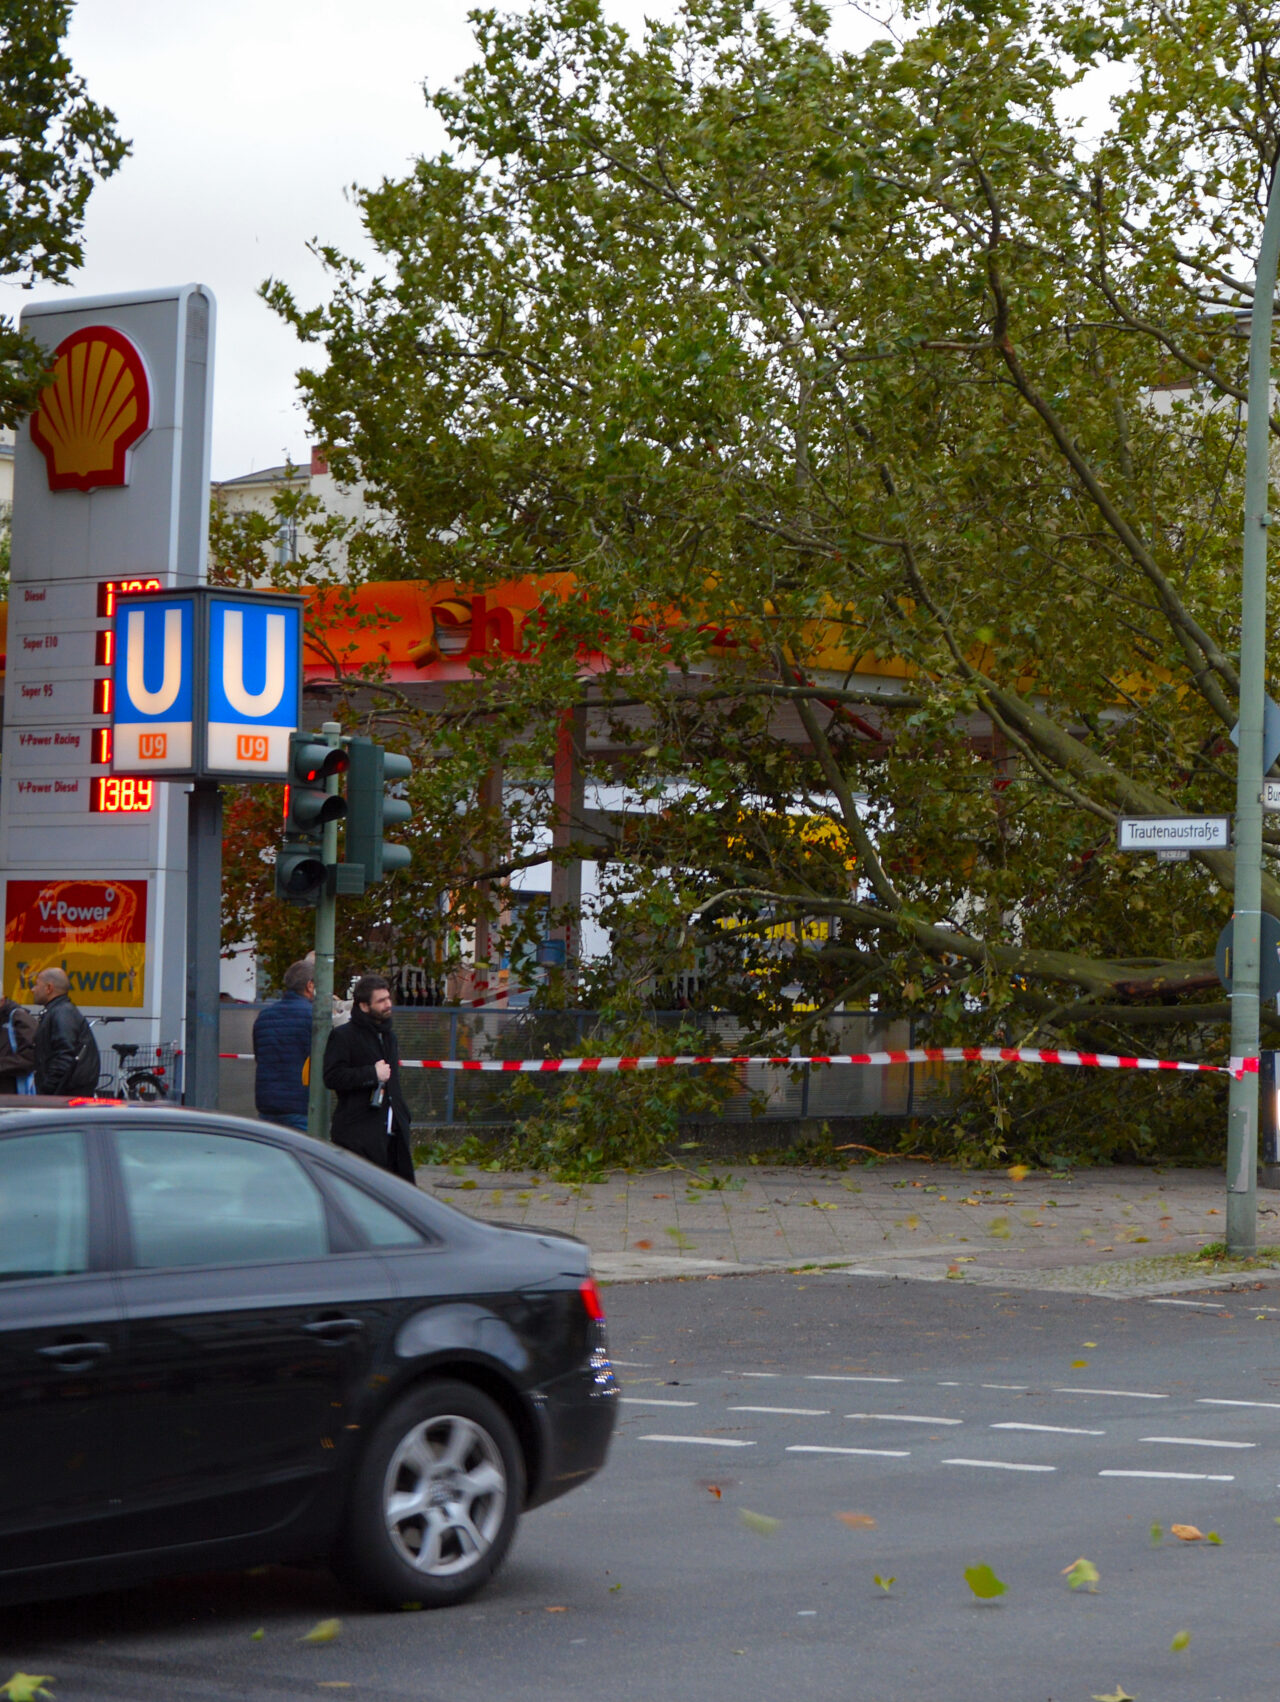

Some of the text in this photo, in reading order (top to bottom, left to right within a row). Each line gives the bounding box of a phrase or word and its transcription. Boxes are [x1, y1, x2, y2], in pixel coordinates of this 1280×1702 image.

[127, 609, 182, 715] U
[222, 610, 286, 718] U
[54, 733, 80, 748] Racing
[141, 735, 165, 757] U9
[240, 737, 266, 759] U9
[54, 780, 79, 793] Diesel
[1127, 822, 1220, 841] Trautenaustraße
[38, 901, 111, 921] V-Power
